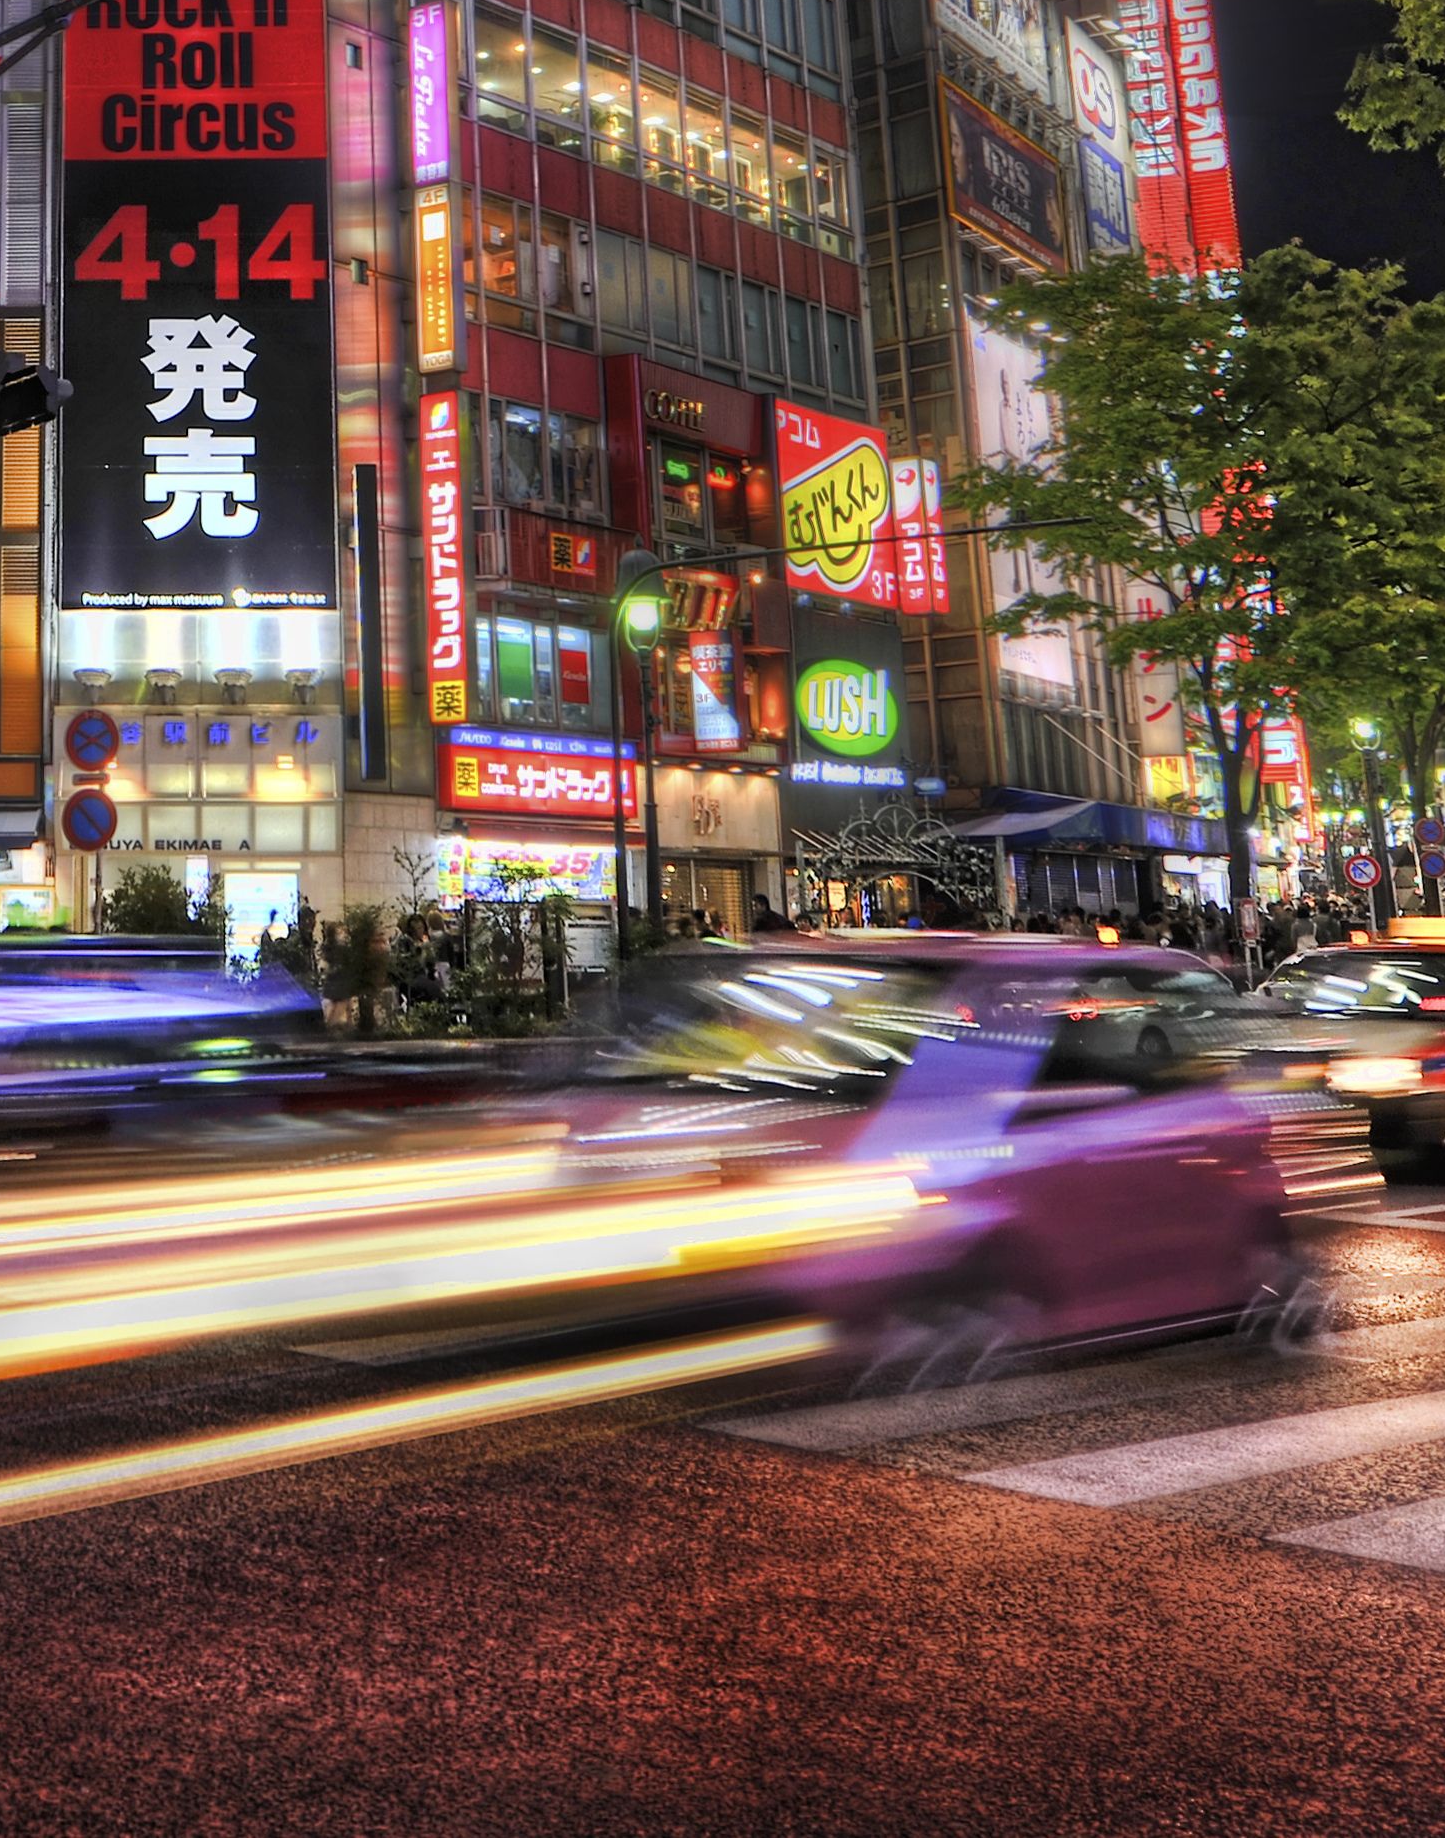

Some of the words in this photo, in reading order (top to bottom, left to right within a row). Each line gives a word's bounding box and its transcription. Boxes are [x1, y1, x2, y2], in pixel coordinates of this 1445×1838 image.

[412, 5, 441, 27] 5F
[142, 31, 254, 89] Roll
[101, 93, 297, 152] Circus
[416, 162, 448, 182] 美容室
[982, 136, 1033, 193] IRIS
[422, 189, 445, 204] 4F
[424, 353, 453, 367] YOGA
[140, 314, 259, 540] 発売
[644, 388, 707, 432] COFFEE
[788, 462, 880, 562] むじんくん
[551, 533, 574, 571] 薬
[902, 522, 925, 582] アコム
[429, 482, 462, 669] サンドラッグ
[871, 569, 896, 602] 3F
[908, 587, 924, 599] 3F
[82, 593, 134, 606] Produced
[135, 593, 148, 608] by
[149, 595, 173, 606] max
[174, 593, 224, 606] matsuura
[437, 684, 462, 717] 薬
[807, 669, 888, 737] LUSH
[120, 721, 318, 745] 谷駅前ビル
[457, 759, 477, 794] 薬
[516, 765, 611, 802] サンドラッグ
[154, 839, 222, 851] EKIMAE
[239, 839, 251, 851] A
